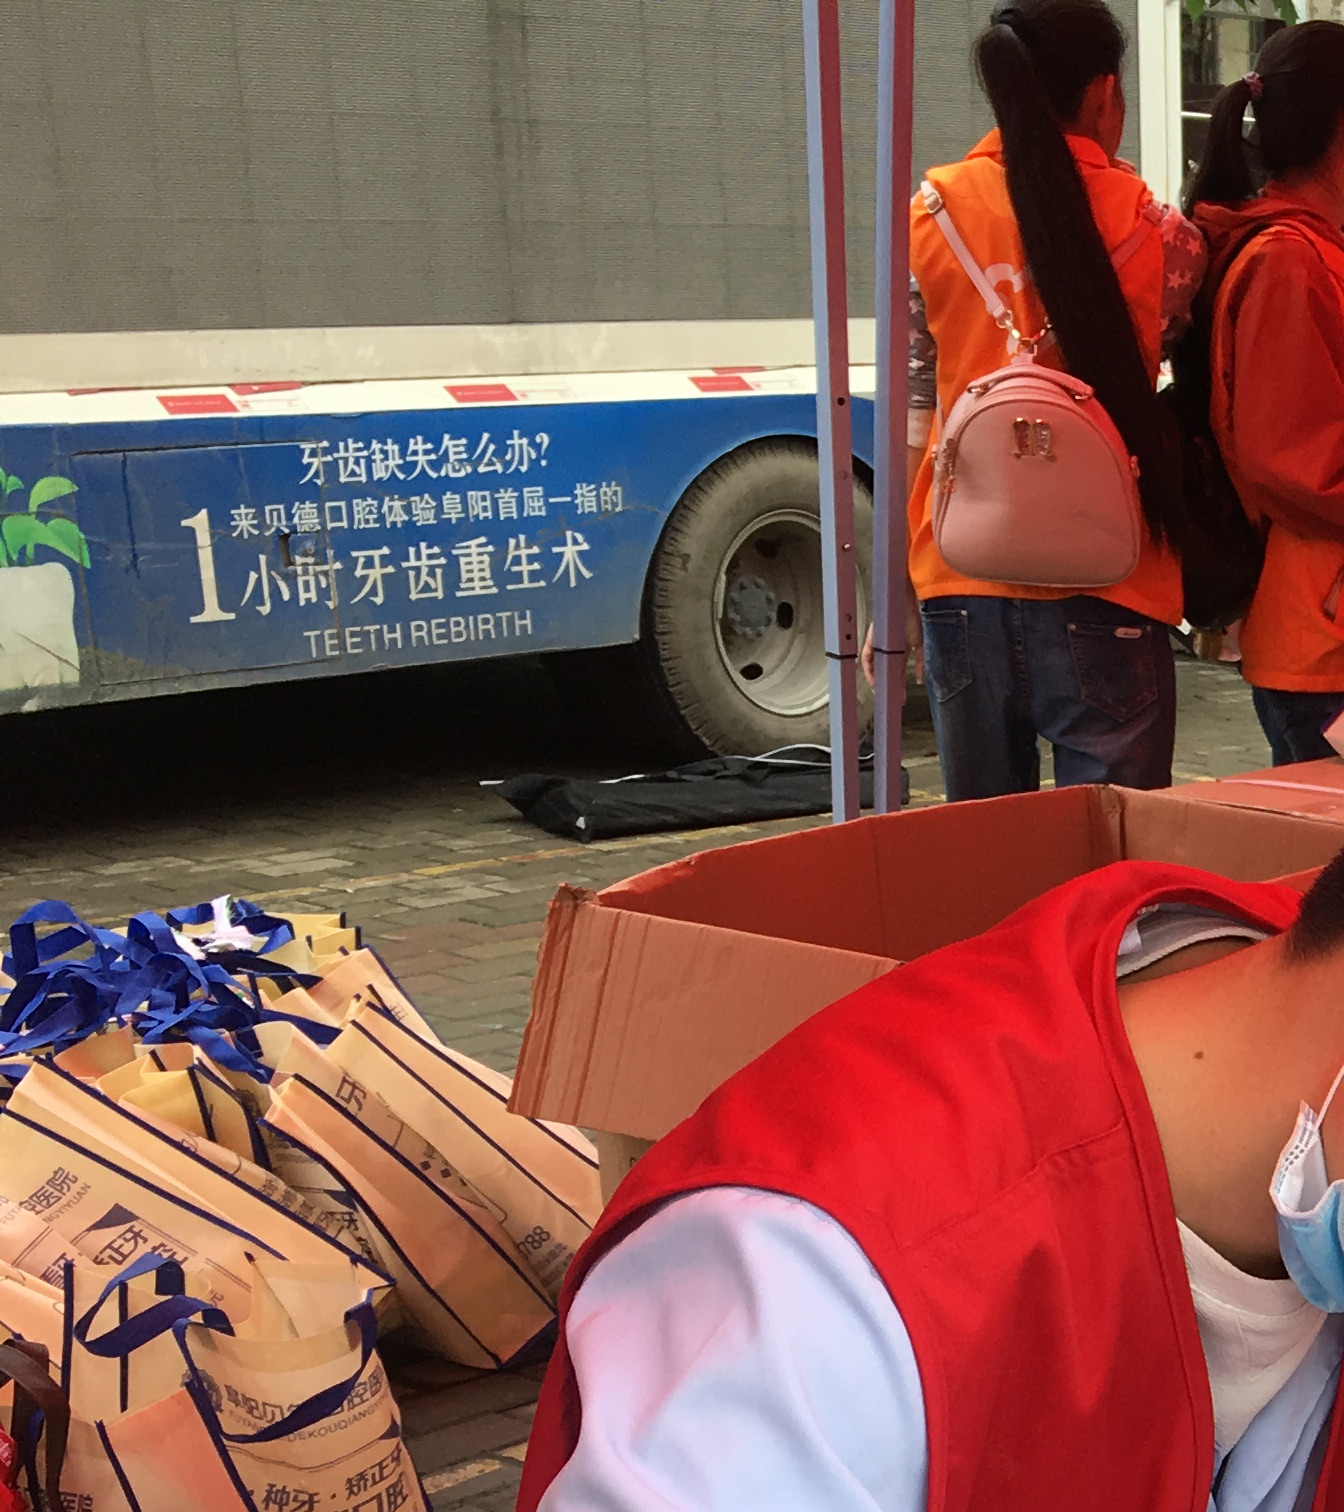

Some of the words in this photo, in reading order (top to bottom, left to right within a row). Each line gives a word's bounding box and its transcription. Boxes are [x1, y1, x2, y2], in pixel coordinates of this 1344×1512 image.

[230, 482, 624, 538] 来贝德口腔体验阜阳首屈一指的
[181, 508, 236, 624] 1
[240, 531, 595, 616] 小时牙齿重生术
[304, 621, 402, 658] TEETH
[410, 609, 533, 647] REBIRTH
